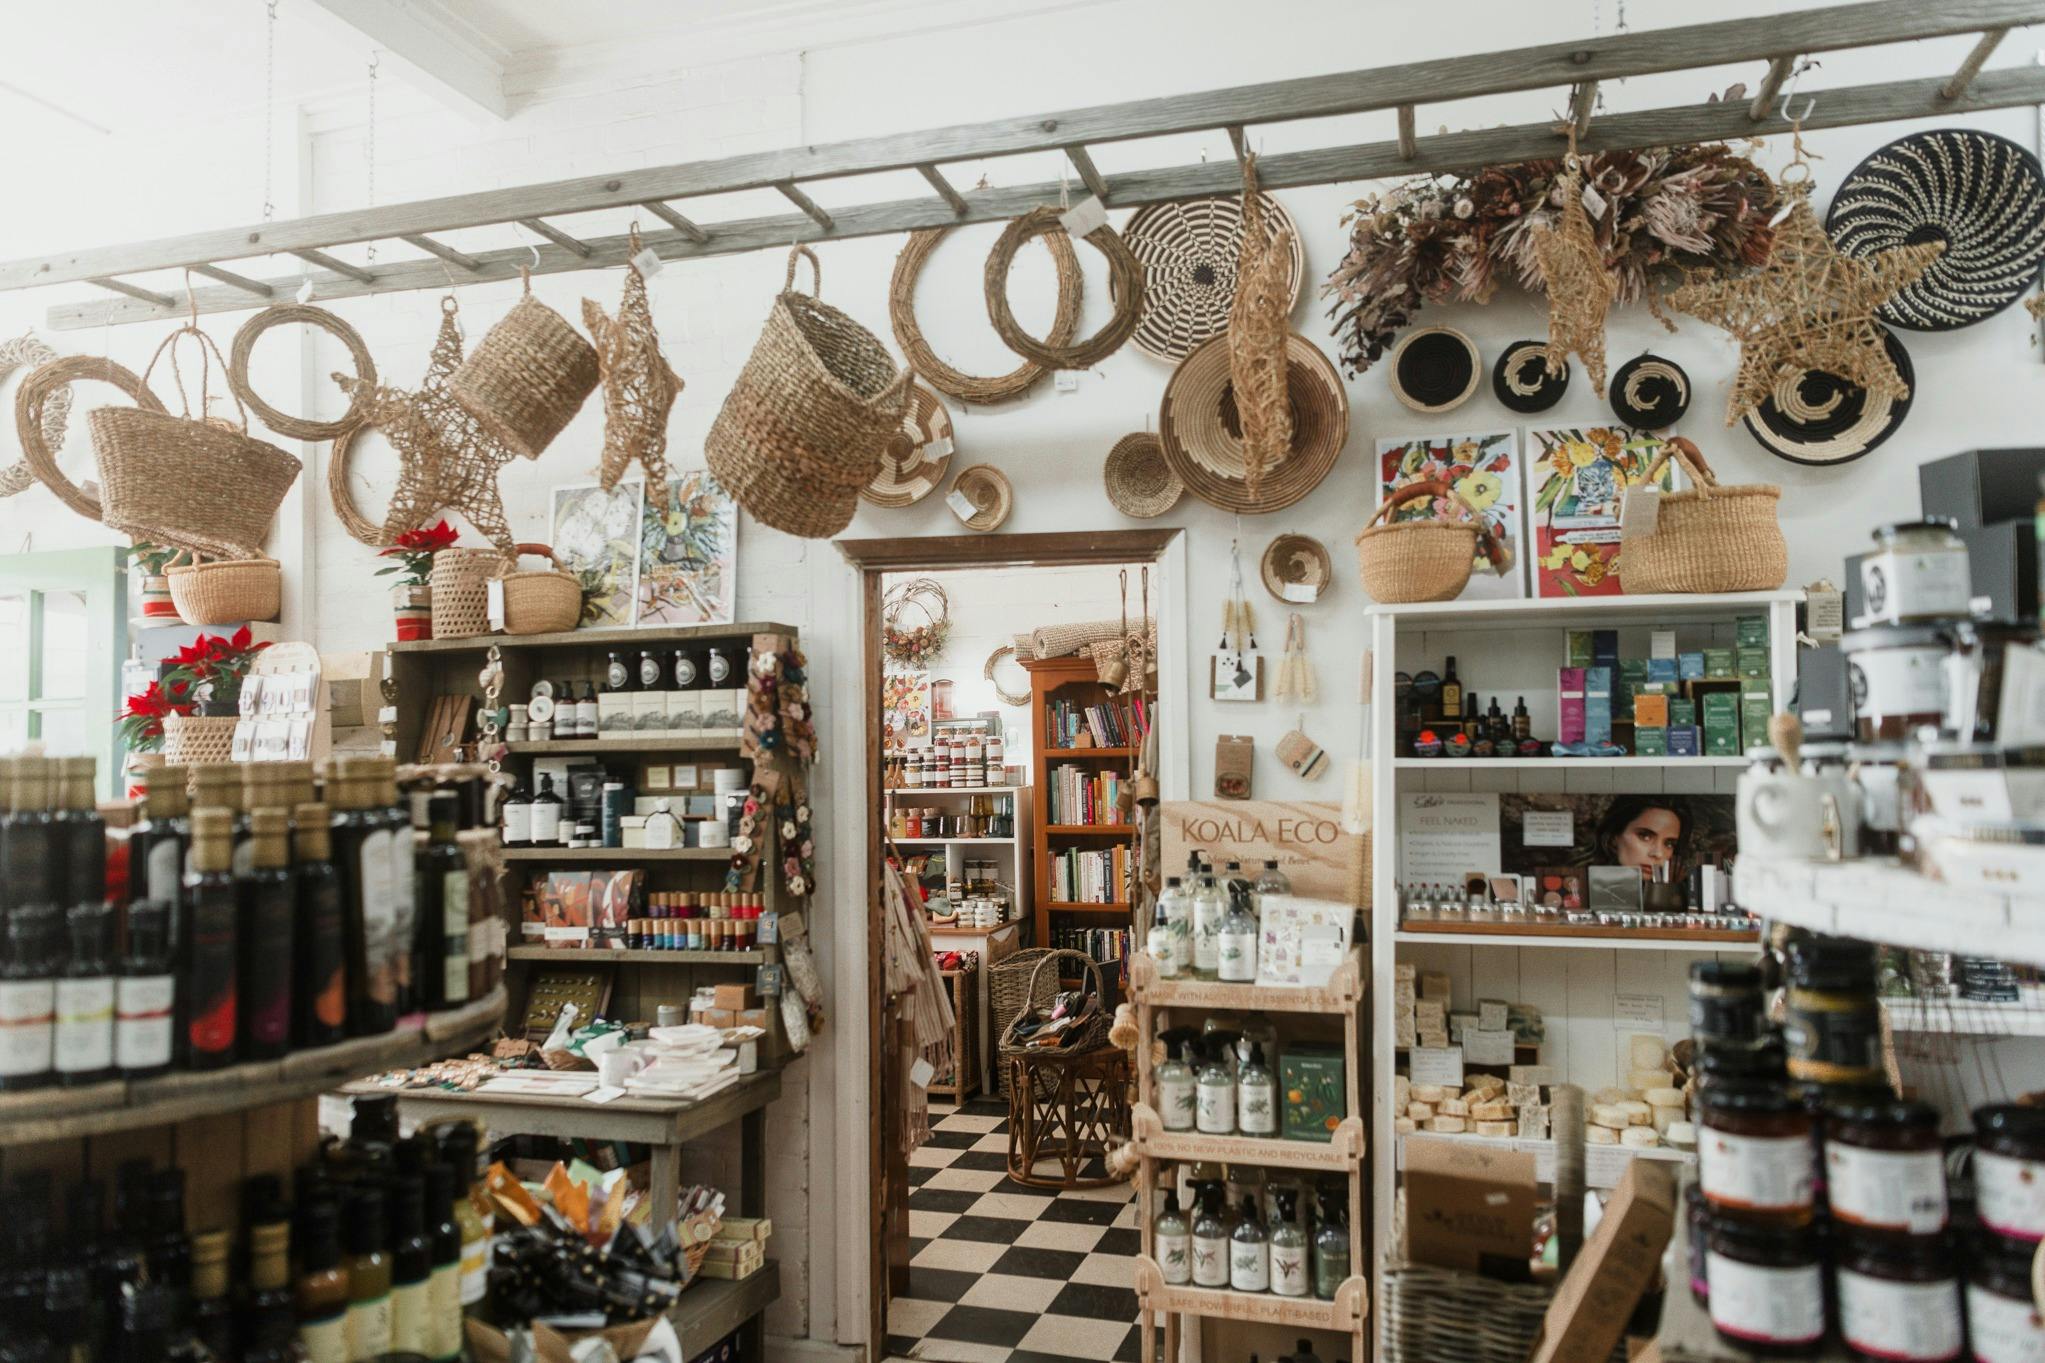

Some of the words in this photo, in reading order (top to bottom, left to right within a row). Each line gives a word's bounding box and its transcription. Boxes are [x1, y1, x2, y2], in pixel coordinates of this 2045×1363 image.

[1181, 819, 1269, 844] KOALA
[1278, 820, 1339, 845] ECO
[1177, 1143, 1191, 1153] NO
[1217, 1146, 1257, 1157] PLASTIC
[1258, 1148, 1278, 1159] AND
